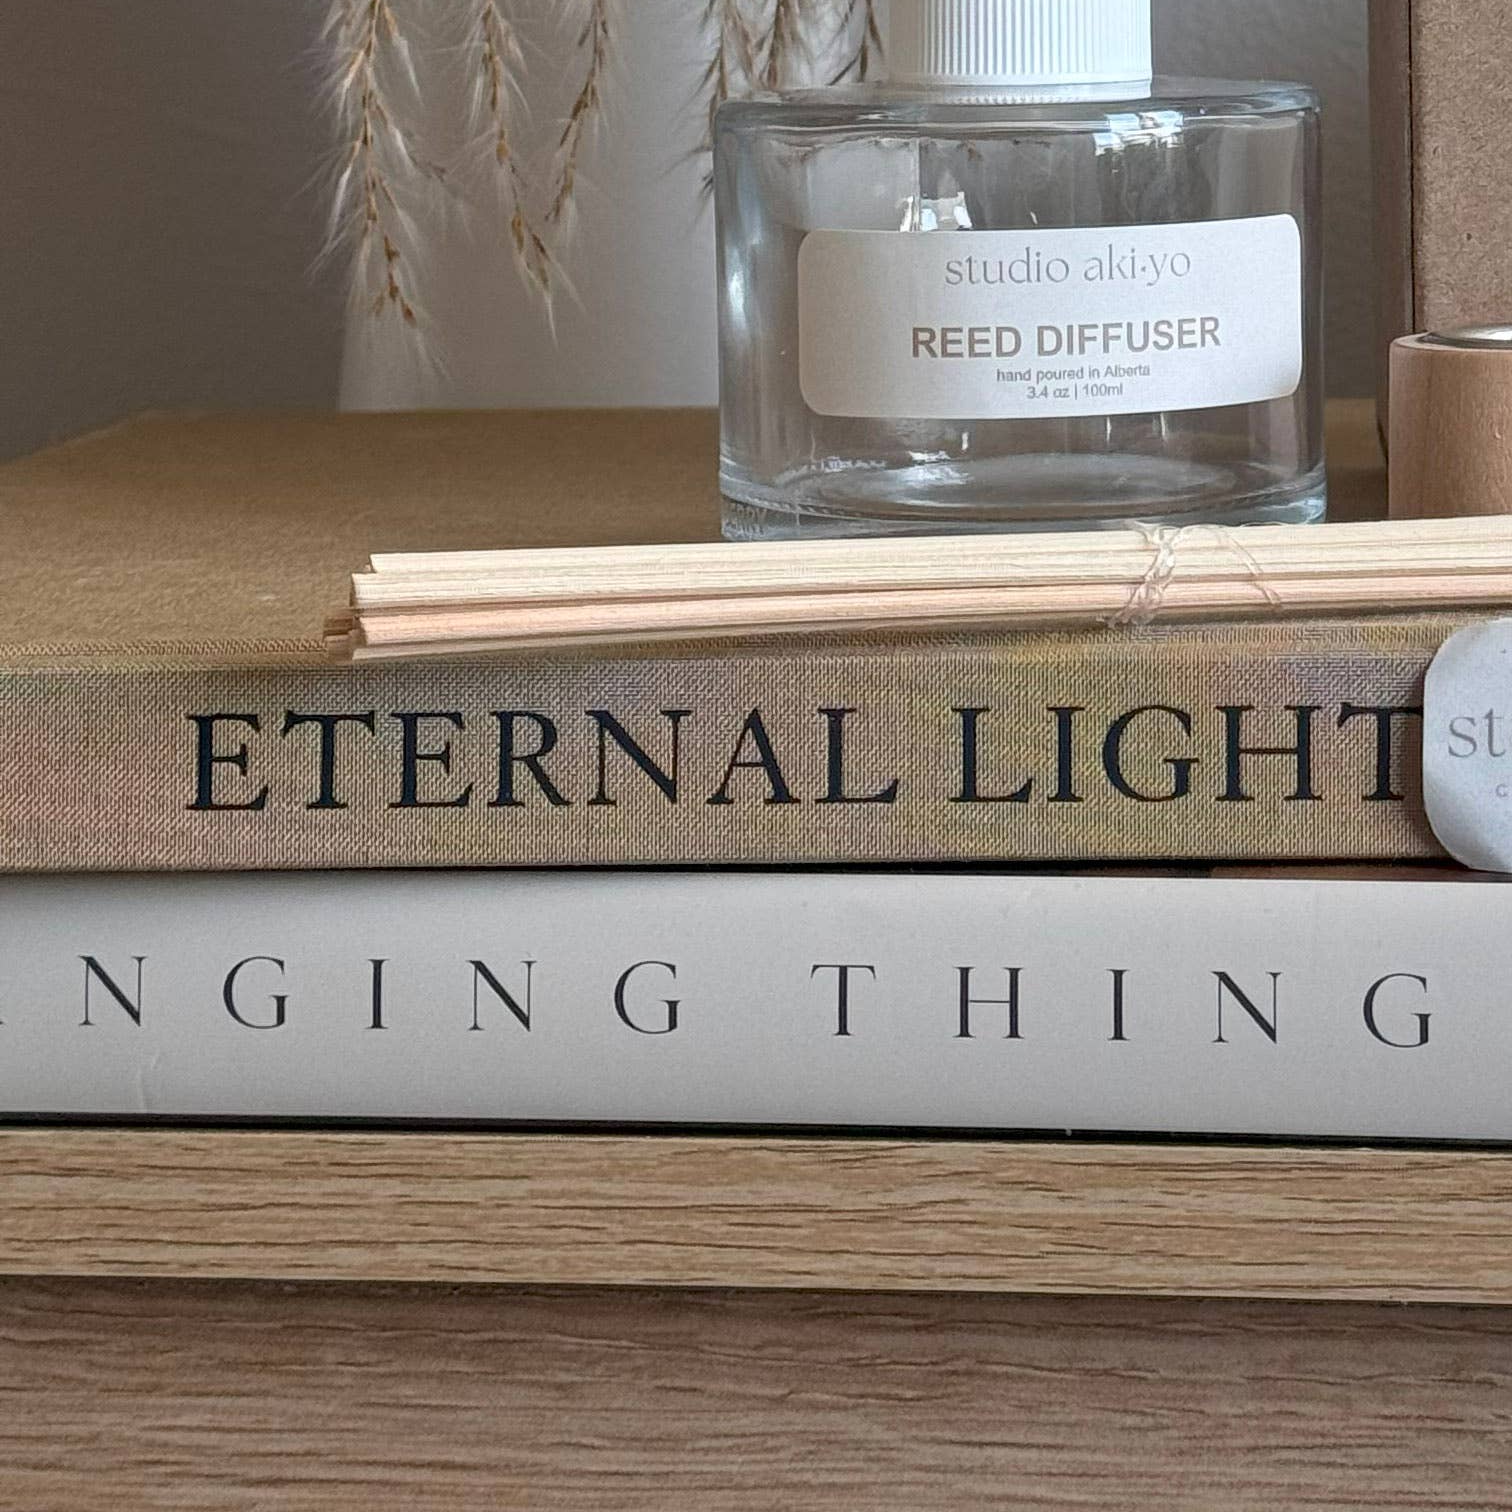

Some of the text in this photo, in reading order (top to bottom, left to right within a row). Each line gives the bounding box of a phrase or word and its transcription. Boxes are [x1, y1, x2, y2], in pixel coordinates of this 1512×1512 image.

[946, 247, 1069, 285] studio
[913, 317, 1220, 358] REED DIFFUSER
[997, 365, 1150, 384] hand poured in Alberta
[1028, 386, 1048, 399] 3.4
[1053, 388, 1069, 398] oz
[1083, 383, 1123, 396] 100ml
[187, 702, 1422, 812] ETERNAL LIGHT
[0, 956, 680, 1034] NGING
